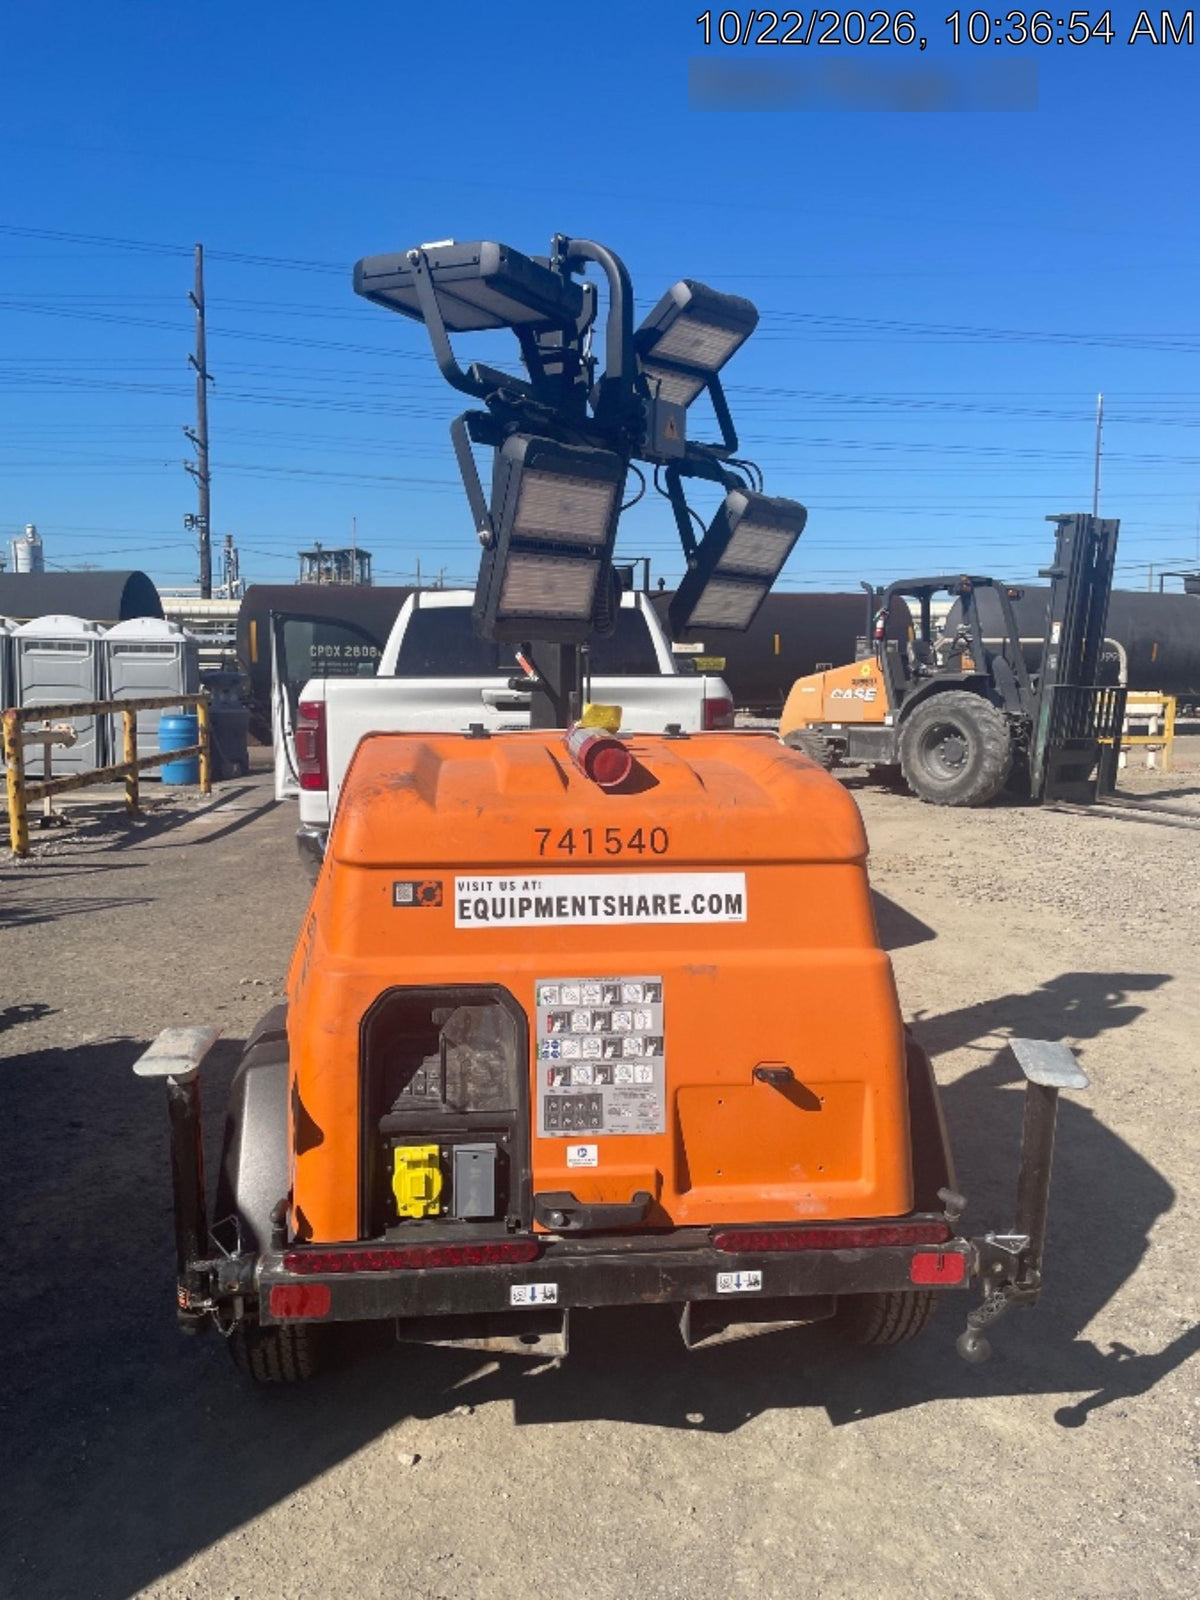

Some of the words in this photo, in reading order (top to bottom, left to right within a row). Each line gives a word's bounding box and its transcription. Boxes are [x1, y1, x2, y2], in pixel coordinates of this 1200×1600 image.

[830, 687, 877, 702] CASE
[535, 827, 669, 855] 741540
[457, 881, 493, 892] VISIT
[499, 881, 516, 891] US
[458, 893, 743, 921] EQUIPMENTSHARE.COM
